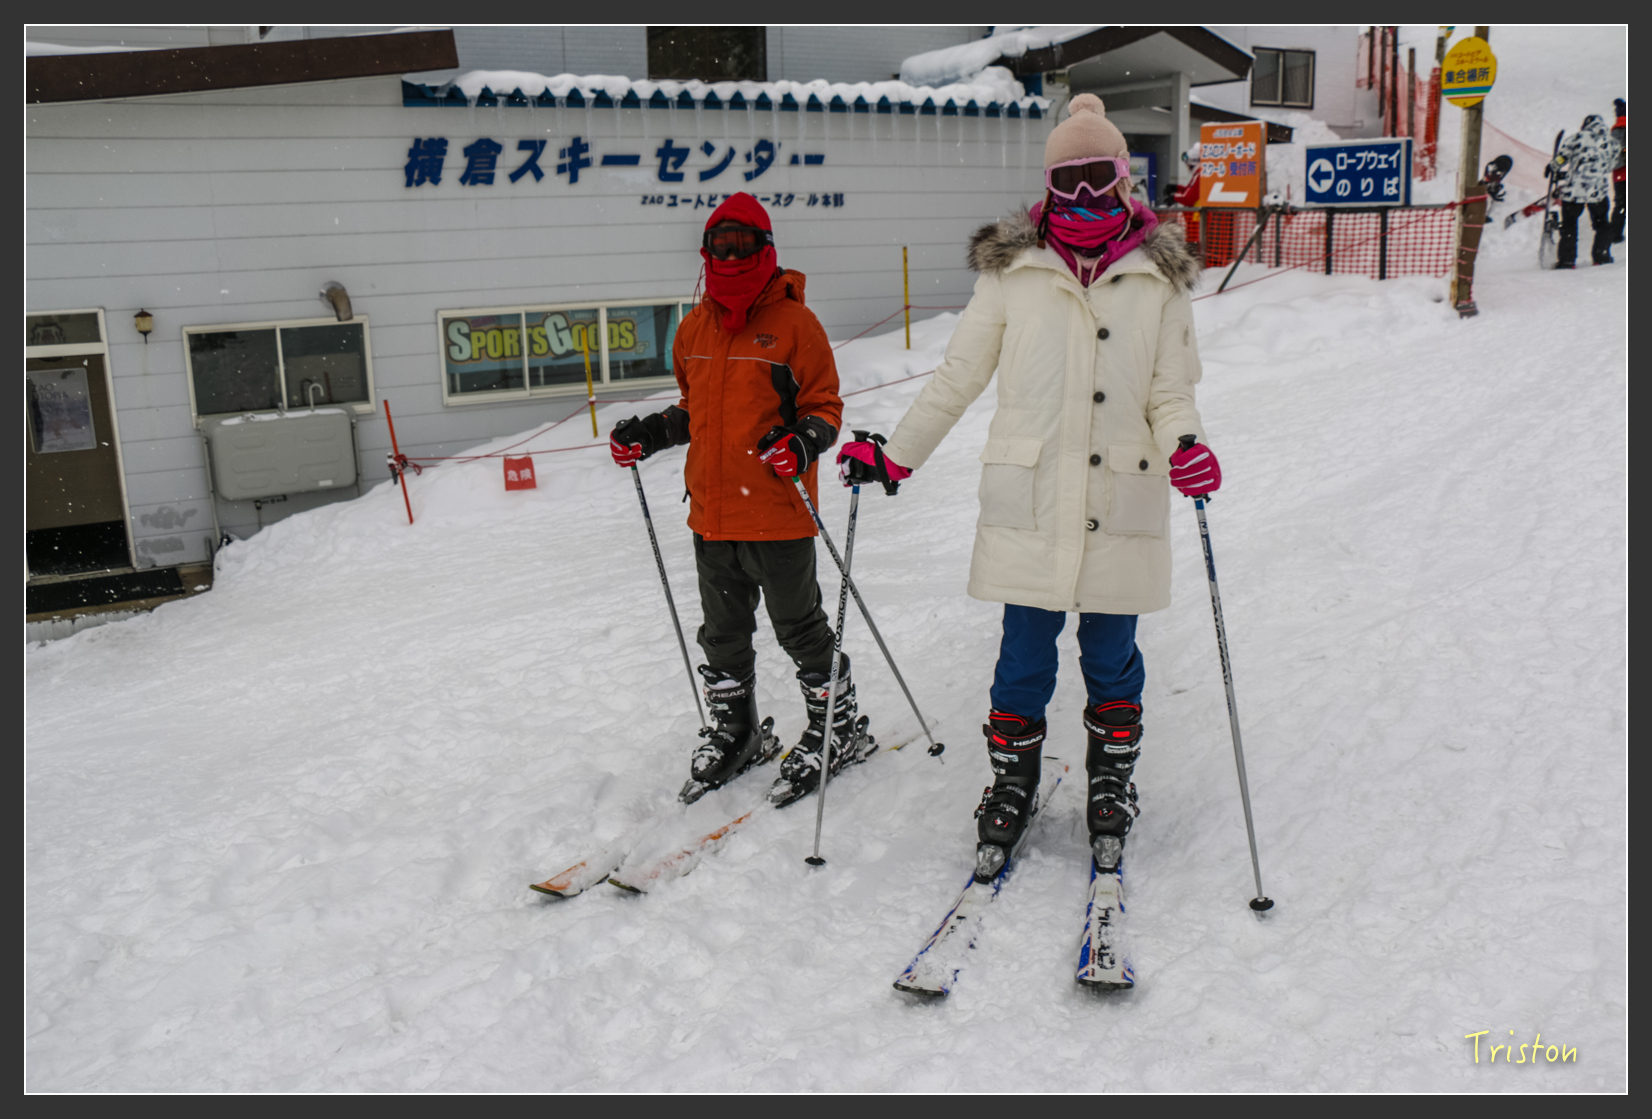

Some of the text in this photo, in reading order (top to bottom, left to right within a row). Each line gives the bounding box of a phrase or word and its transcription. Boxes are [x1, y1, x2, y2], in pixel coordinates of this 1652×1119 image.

[1445, 66, 1491, 85] 集合場所
[404, 136, 825, 187] 横倉スキーセンター
[1336, 149, 1401, 171] ロープウェイ
[1335, 176, 1400, 197] のりば
[834, 570, 848, 653] ROSSIGNOL
[712, 688, 746, 699] HEAD
[1013, 734, 1043, 747] HEAD
